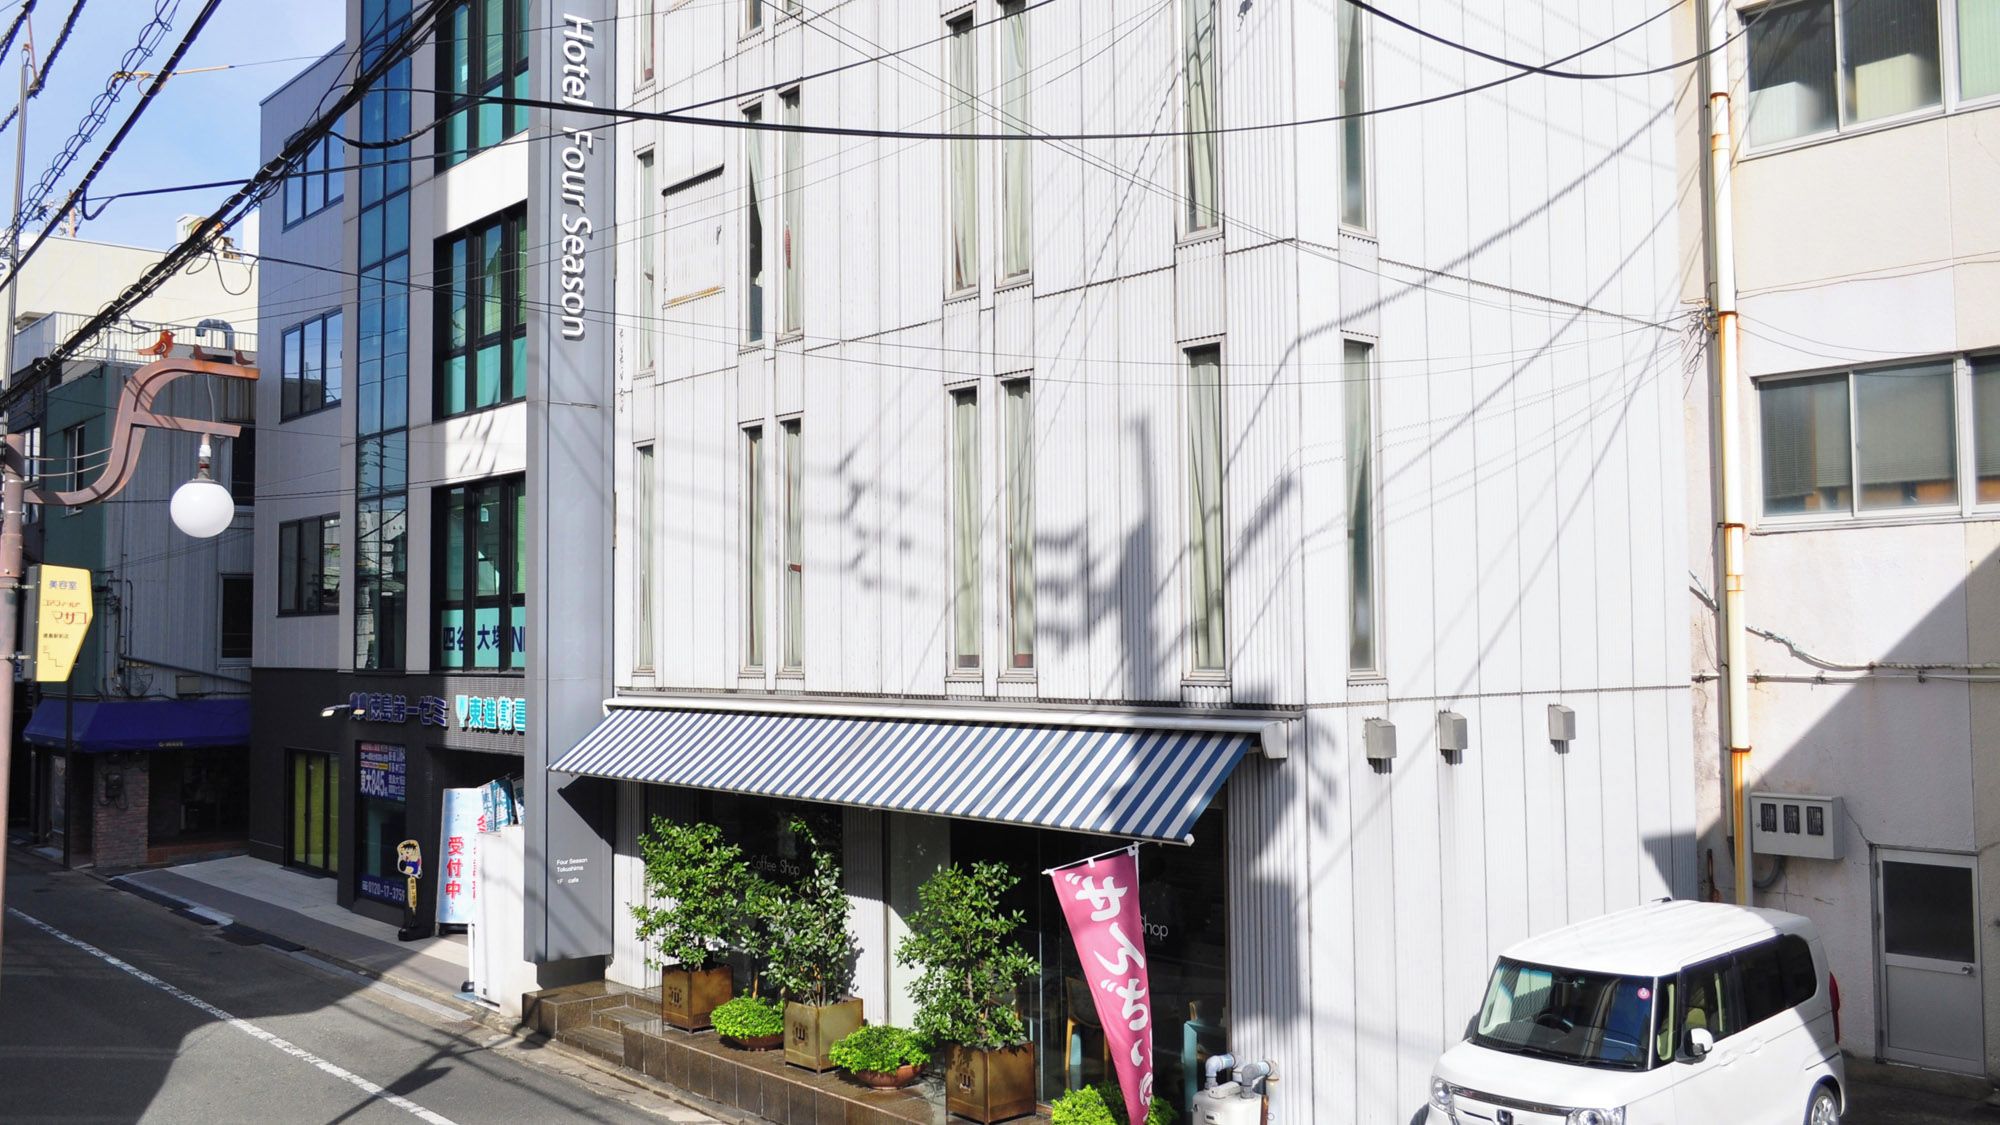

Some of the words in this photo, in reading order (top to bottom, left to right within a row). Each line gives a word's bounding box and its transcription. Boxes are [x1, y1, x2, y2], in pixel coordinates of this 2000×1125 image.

[561, 13, 594, 108] Hotel
[561, 126, 593, 208] Four
[560, 213, 592, 337] Season
[446, 836, 464, 899] 受付中
[780, 858, 801, 879] Shop
